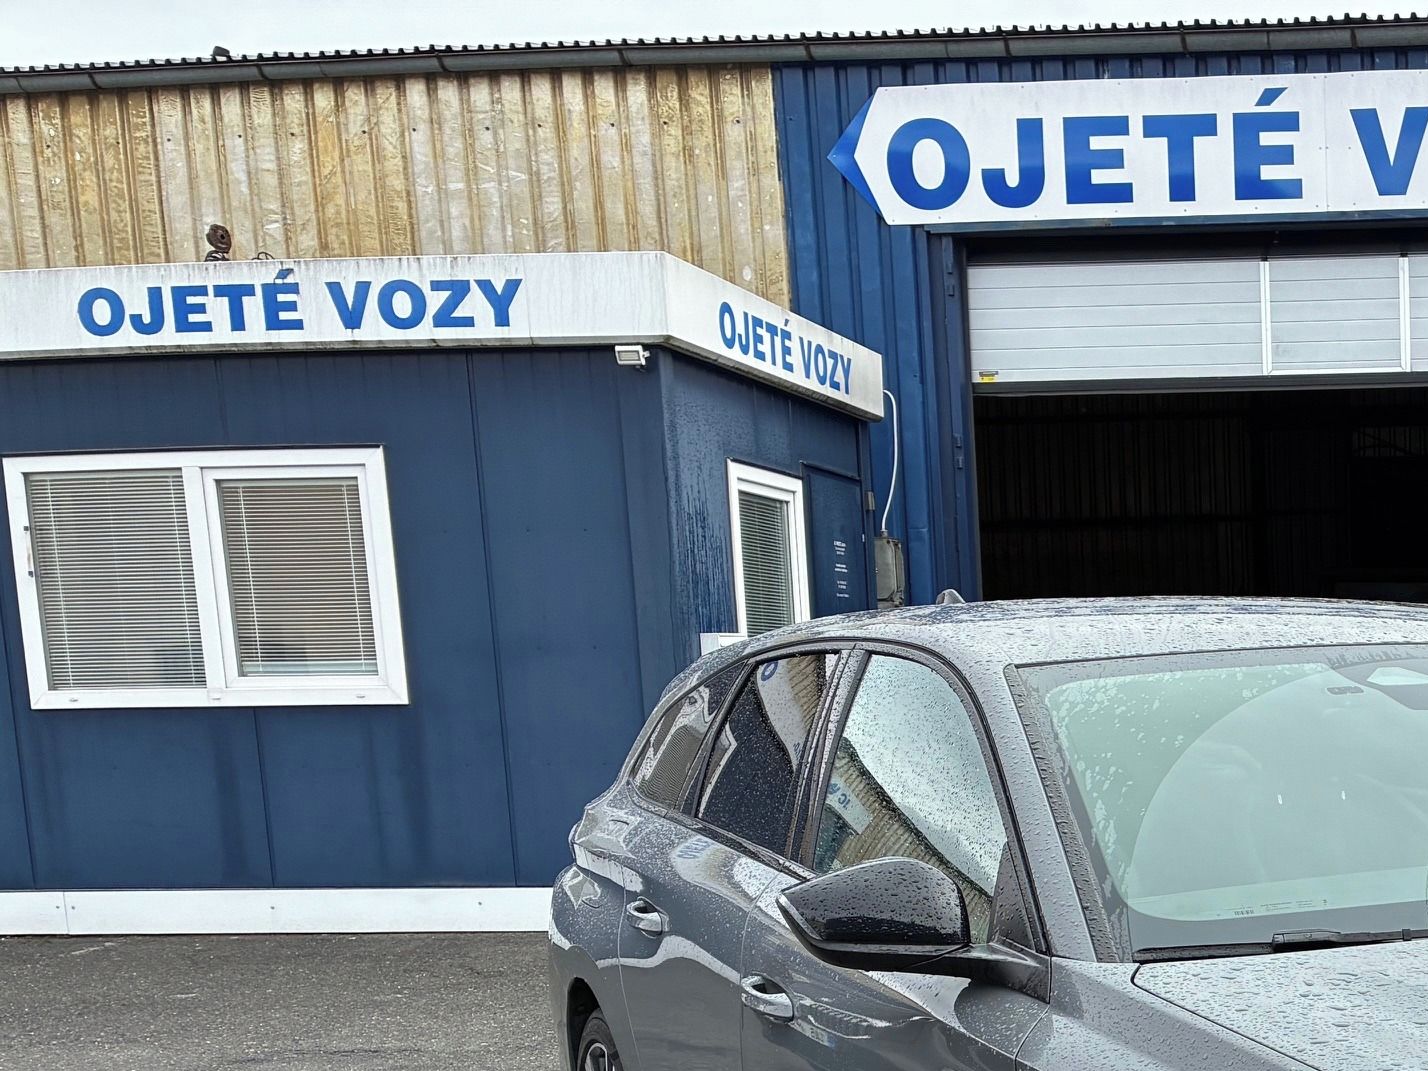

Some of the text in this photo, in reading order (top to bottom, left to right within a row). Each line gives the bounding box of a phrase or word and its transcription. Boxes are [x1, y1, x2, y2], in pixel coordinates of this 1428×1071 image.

[887, 87, 1303, 211] OJETÉ
[77, 267, 523, 337] OJETÉ VOZY
[719, 302, 852, 396] OJETÉ VOZY
